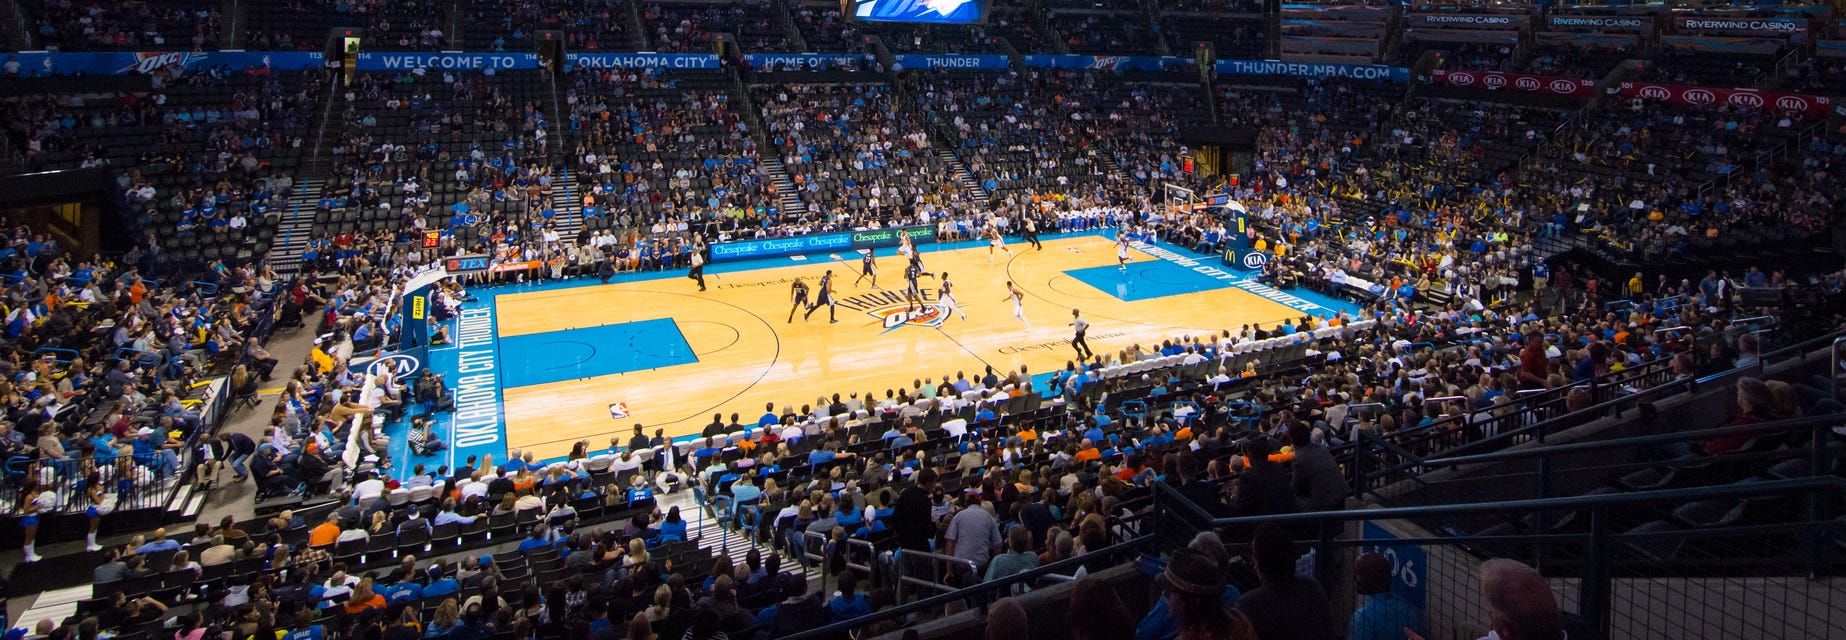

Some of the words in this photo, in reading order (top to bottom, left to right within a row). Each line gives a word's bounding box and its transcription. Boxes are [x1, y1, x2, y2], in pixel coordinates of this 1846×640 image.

[1426, 15, 1474, 23] RIVERWIND
[1475, 16, 1509, 24] CASINO
[1553, 17, 1604, 25] RIVERWIND
[1604, 18, 1641, 27] CASINO
[1686, 20, 1748, 29] RIVERWIND
[1750, 21, 1796, 30] CASINO
[137, 52, 178, 74] OKC
[382, 55, 483, 68] WELCOME
[490, 56, 515, 68] TO
[579, 56, 669, 68] OKLAHOMA
[674, 56, 708, 68] CITY
[765, 57, 804, 68] HOME
[926, 57, 980, 68] THUNDER
[1095, 56, 1116, 69] OKC
[1233, 61, 1390, 79] THUNDER.NBA.COM
[809, 234, 849, 247] Chesapeake
[853, 231, 892, 243] Chesapeake
[714, 243, 758, 255] Chesapeake
[763, 239, 804, 251] Chesapeake
[1230, 278, 1321, 311] THUNDER
[459, 307, 493, 349] THUNDER
[458, 349, 495, 374] CITY
[456, 373, 498, 447] OKLAHOMA
